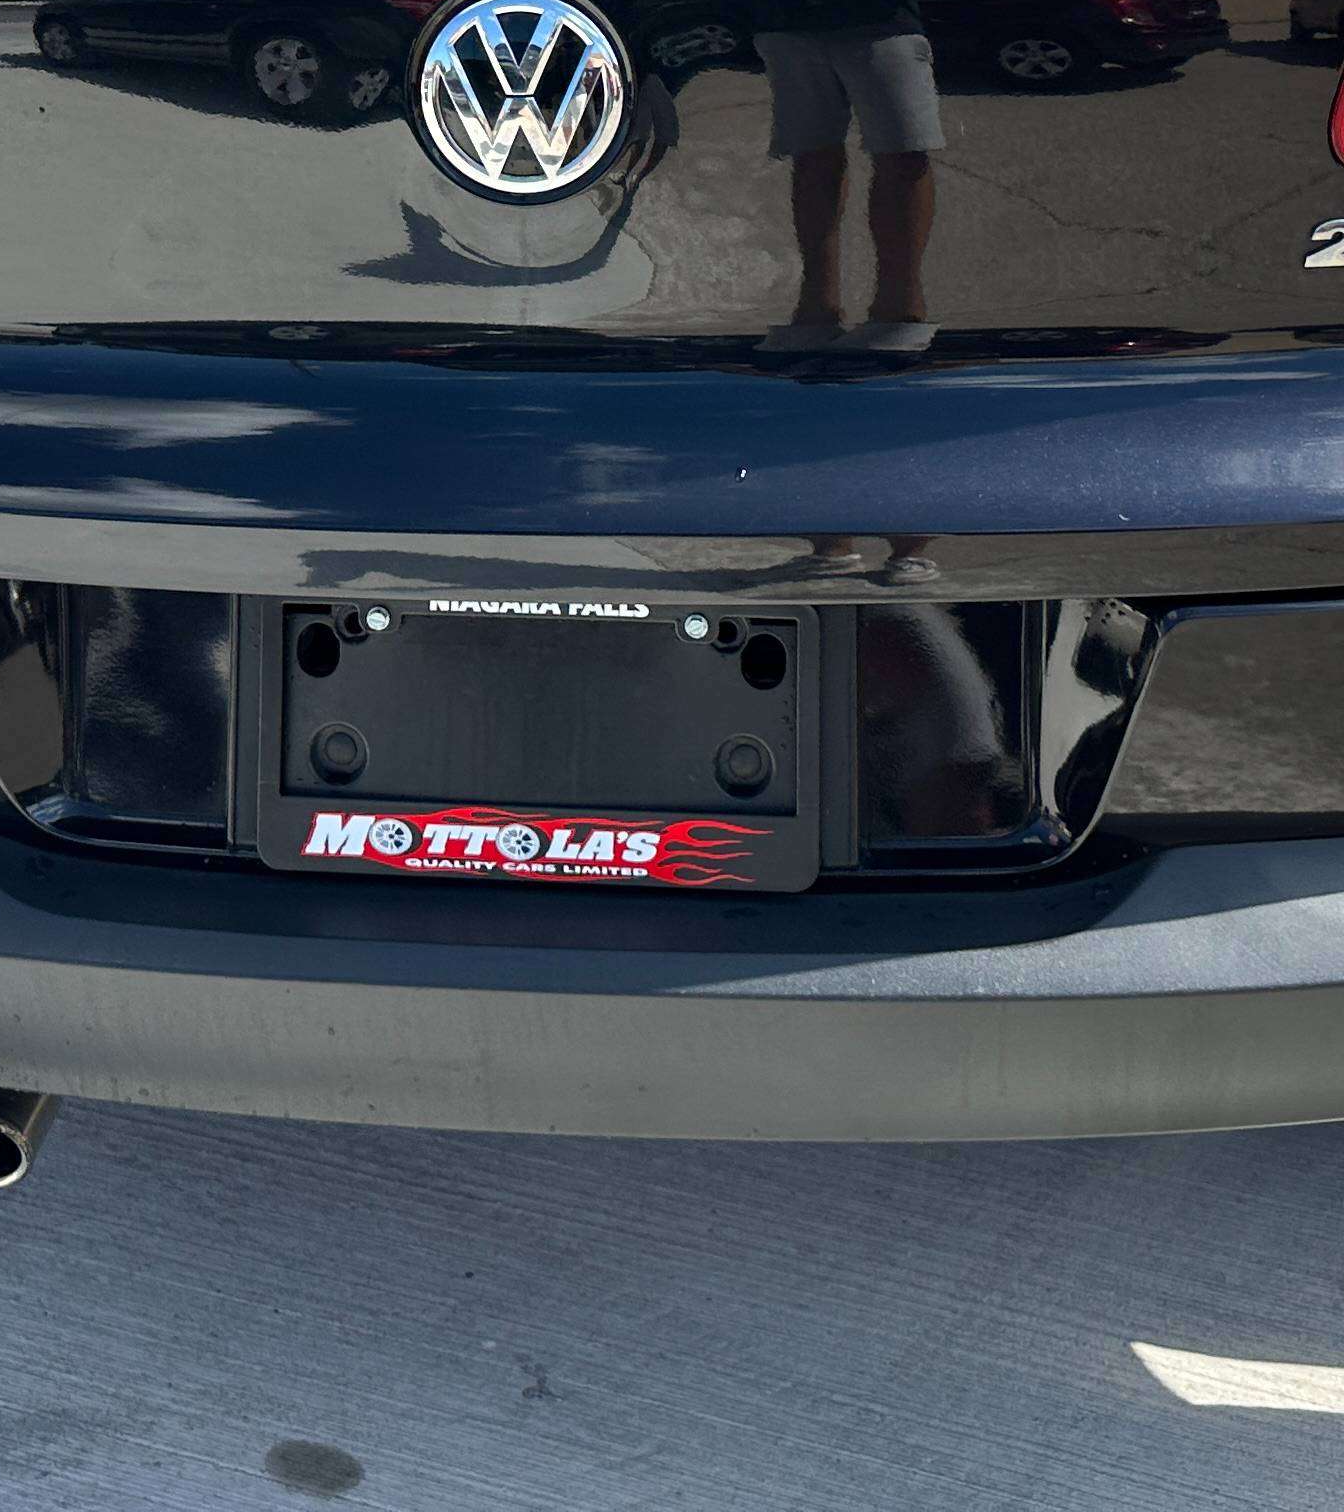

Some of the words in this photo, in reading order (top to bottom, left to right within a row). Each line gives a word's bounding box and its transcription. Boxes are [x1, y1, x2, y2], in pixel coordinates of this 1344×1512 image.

[305, 813, 661, 862] MOTTOLA'S
[405, 857, 497, 871] QUALITY
[503, 861, 556, 873] CARS
[563, 864, 649, 877] LIMITED
